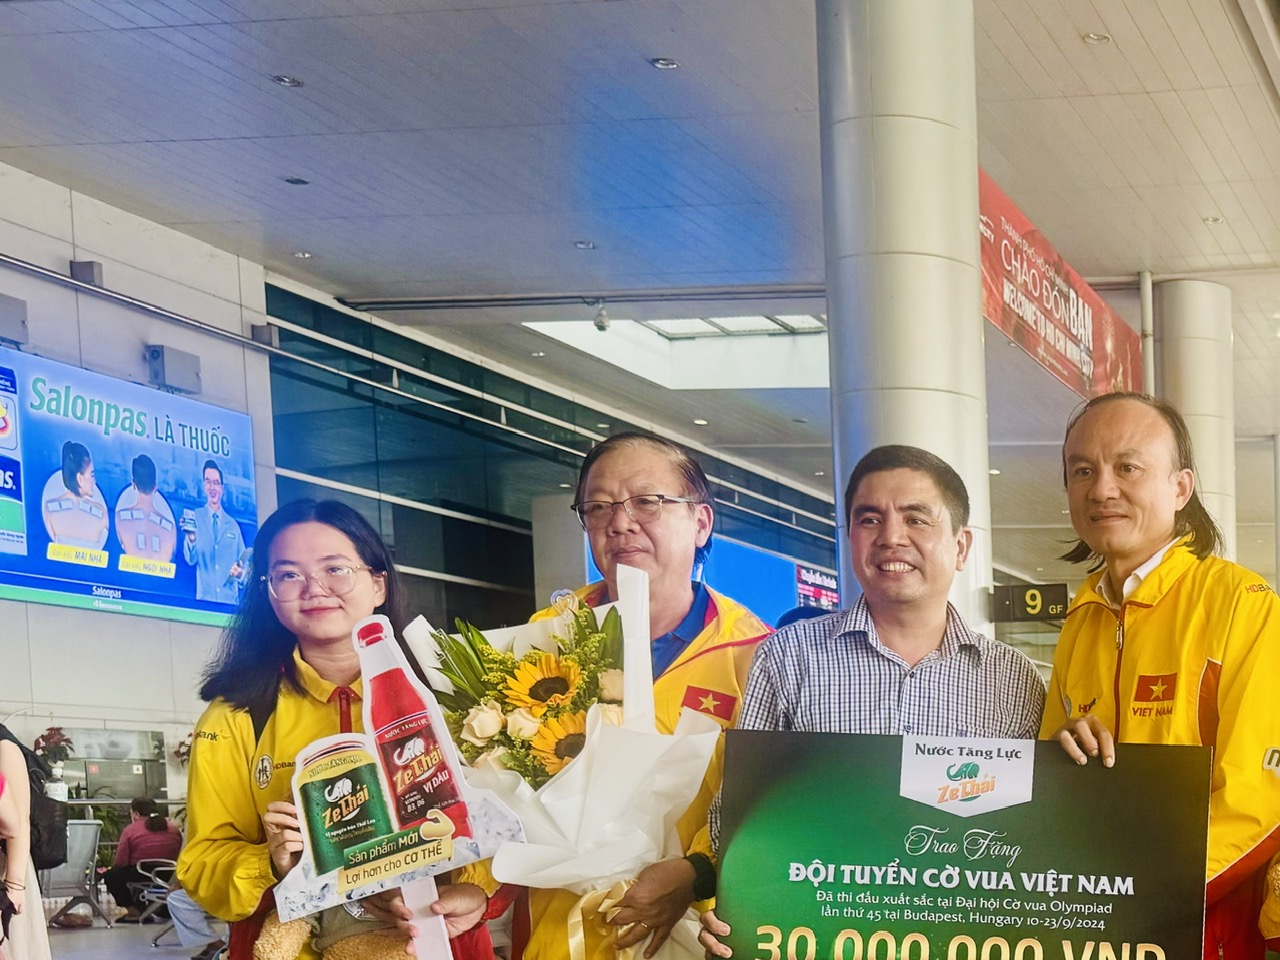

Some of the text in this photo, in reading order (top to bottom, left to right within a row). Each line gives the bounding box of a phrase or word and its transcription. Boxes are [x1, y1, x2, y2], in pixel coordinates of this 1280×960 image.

[1001, 239, 1040, 297] CHÀO
[1042, 278, 1069, 330] ĐÓN
[1003, 277, 1036, 330] WELCOME
[30, 376, 147, 438] Salonpas
[154, 415, 175, 445] LÀ
[178, 423, 230, 457] THUỐC
[92, 586, 122, 599] Salonpas
[1024, 589, 1064, 614] 9 GF
[1132, 706, 1173, 717] VIET NAM
[915, 742, 1022, 761] Nước Tăng Lực
[369, 838, 397, 859] phẩm
[398, 831, 419, 847] MỚI
[904, 825, 960, 856] Trao
[346, 840, 443, 885] Lợi hơn cho CƠ THỂ
[788, 858, 1135, 897] ĐỘI TUYỂN CỜ VUA VIỆT NAM
[816, 890, 1113, 916] Đã thi đấu xuất sắc tại Đại hội Cờ vua Olympiad
[821, 904, 1106, 931] lần thứ 45 tại Budapest, Hungary 10-23/9/2024
